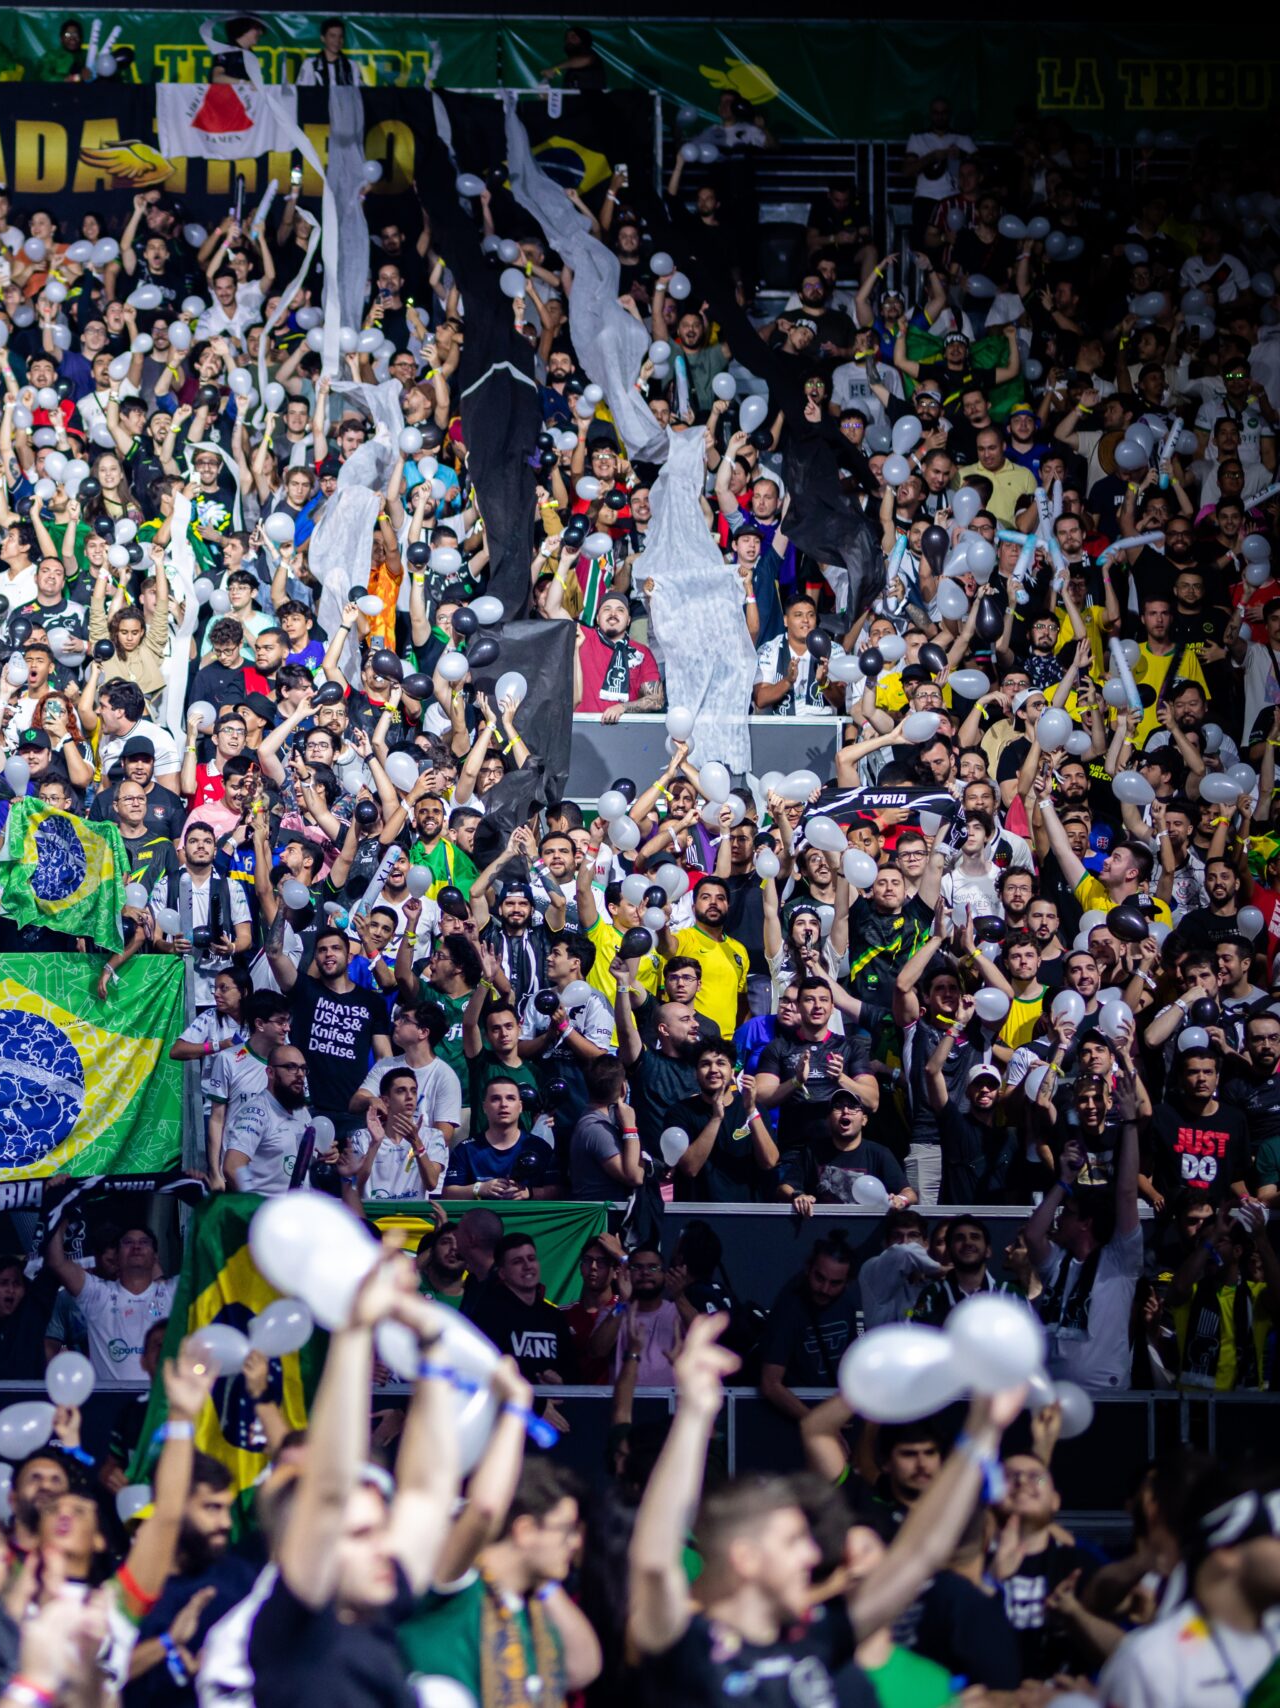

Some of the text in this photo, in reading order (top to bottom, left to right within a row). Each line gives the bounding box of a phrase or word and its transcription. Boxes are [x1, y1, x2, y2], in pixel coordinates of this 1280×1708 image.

[1036, 58, 1280, 112] LA TRIBO
[310, 1023, 357, 1045] Knife&
[308, 1038, 357, 1060] Defuse.
[1173, 1127, 1231, 1158] JUST
[1181, 1153, 1218, 1182] DO
[510, 1330, 558, 1360] VANS
